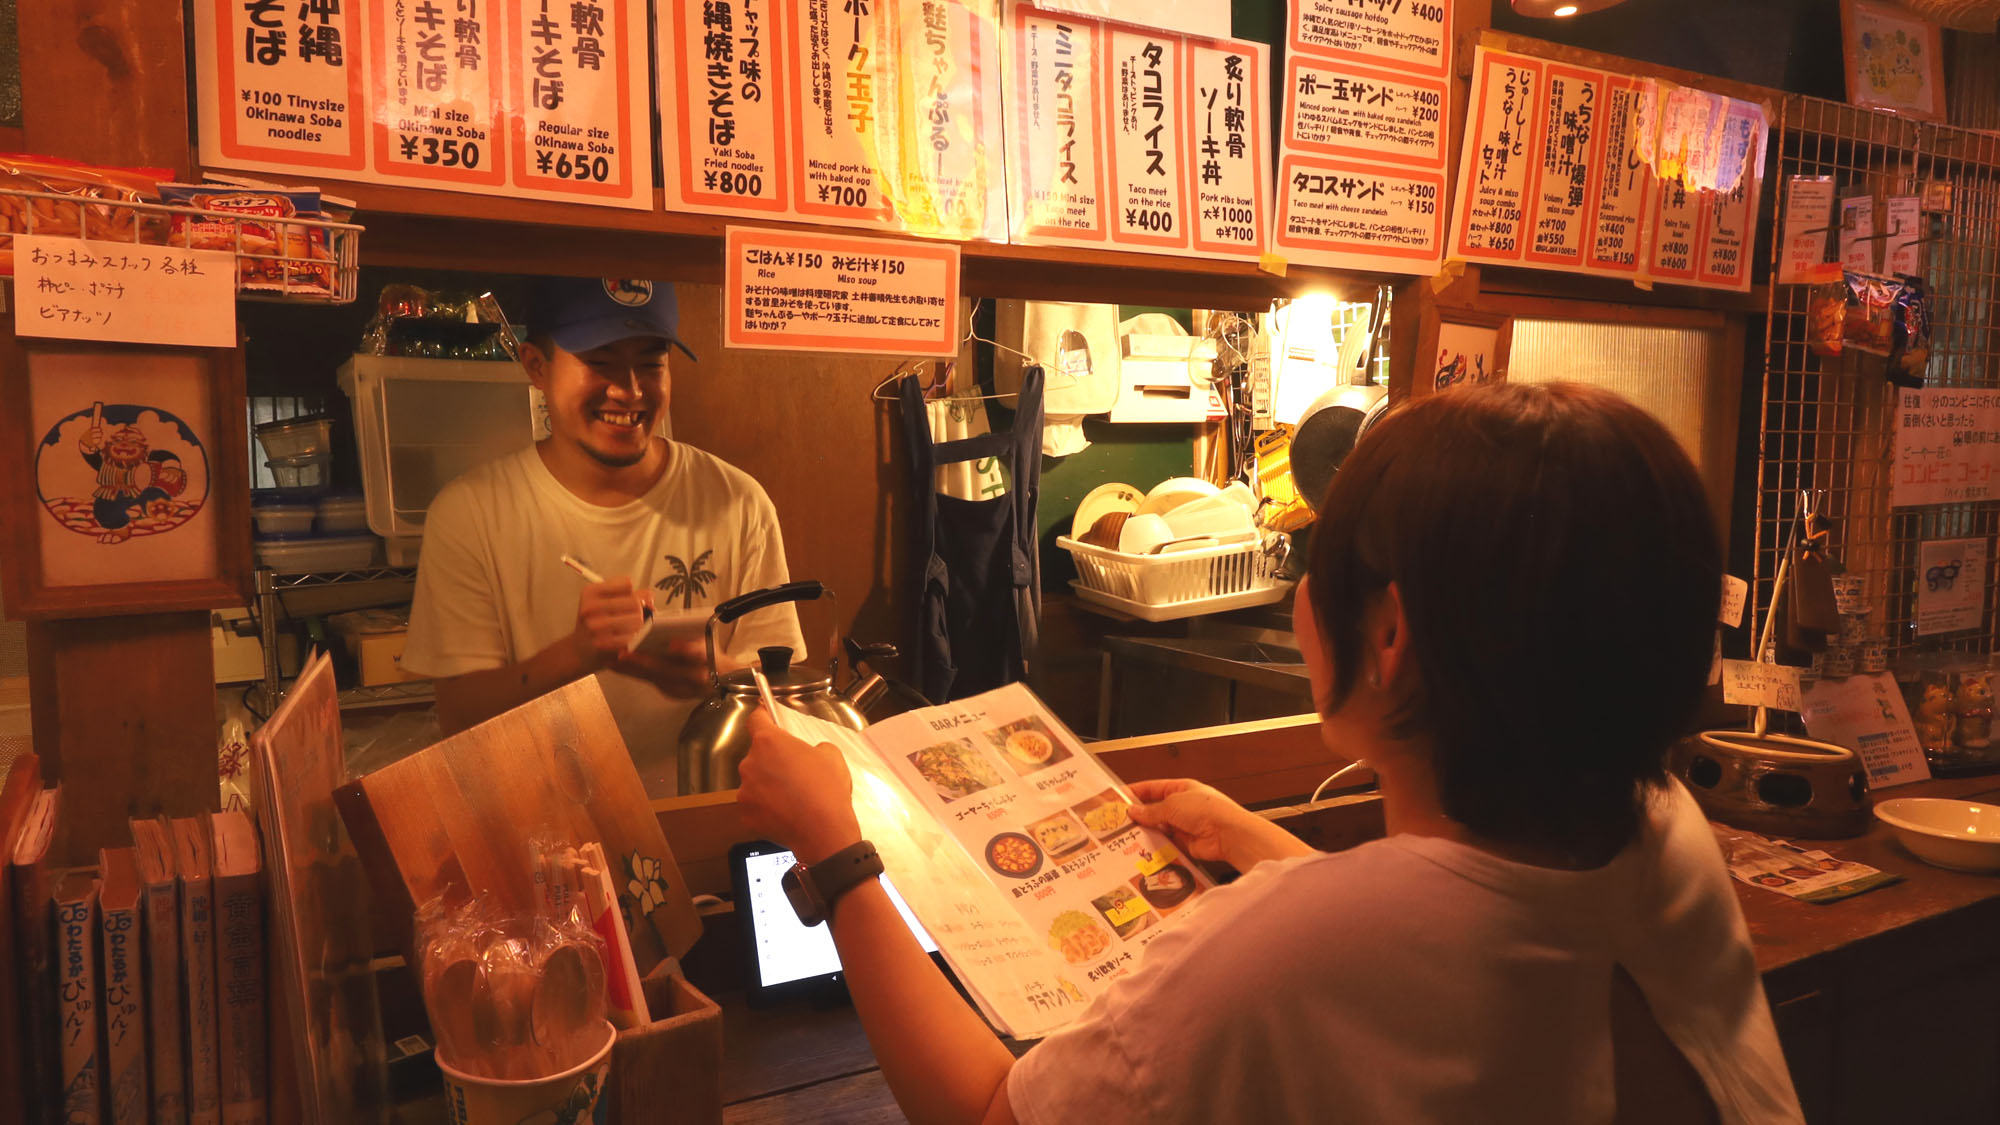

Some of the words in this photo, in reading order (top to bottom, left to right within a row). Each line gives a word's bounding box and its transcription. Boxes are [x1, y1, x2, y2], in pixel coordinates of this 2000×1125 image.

[1314, 2, 1334, 14] Spicy
[1335, 7, 1363, 20] sausage
[1365, 11, 1389, 25] hotdog
[1411, 2, 1443, 24] ¥400
[245, 0, 287, 66] そば
[298, 0, 343, 66] 沖縄
[570, 0, 605, 71] 軟骨
[1299, 73, 1394, 107] ポー玉サンド
[1412, 89, 1439, 107] ¥400
[241, 89, 282, 107] ¥100
[287, 94, 345, 113] Tinysize
[1054, 24, 1078, 184] ミニタコライス
[1141, 41, 1166, 177] タコライス
[1224, 55, 1246, 159] 炙り軟骨
[246, 106, 305, 124] Okinawa
[309, 113, 342, 129] Soba
[413, 105, 441, 120] Mini
[445, 109, 470, 123] size
[1299, 101, 1321, 112] Minced
[1321, 105, 1336, 115] pork
[1337, 107, 1350, 116] ham
[1353, 109, 1366, 119] with
[1366, 111, 1384, 121] baked
[1385, 115, 1396, 124] egg
[1396, 116, 1422, 127] sandwich
[1412, 105, 1438, 122] ¥200
[1512, 70, 1531, 156] じゅーしーと
[268, 127, 322, 142] noodles
[398, 119, 452, 135] Okinawa
[456, 126, 486, 140] Soba
[538, 120, 583, 136] Regular
[587, 127, 610, 139] size
[1493, 67, 1517, 181] うちなー味噌汁
[534, 135, 583, 151] Okinawa
[587, 141, 615, 155] Soba
[1200, 87, 1222, 186] ソーキ丼
[1558, 110, 1578, 177] 味噌汁
[1568, 82, 1594, 208] うちなー爆弾
[400, 134, 480, 169] ¥350
[713, 148, 732, 158] Yaki
[735, 150, 755, 160] Soba
[535, 150, 609, 182] ¥650
[704, 158, 728, 169] Fried
[731, 162, 764, 173] noodles
[809, 160, 837, 171] Minced
[839, 163, 859, 174] pork
[1480, 144, 1495, 185] セット
[703, 170, 762, 197] ¥800
[809, 172, 828, 181] with
[829, 174, 853, 184] baked
[855, 178, 870, 187] egg
[1128, 183, 1147, 195] Taco
[1293, 172, 1385, 201] タコスサンド
[818, 184, 867, 208] ¥700
[1079, 194, 1095, 205] size
[1201, 192, 1219, 204] Pork
[1220, 193, 1235, 205] ribs
[1236, 196, 1253, 207] bowl
[1408, 183, 1435, 199] ¥300
[1479, 185, 1496, 196] Juicy
[1498, 187, 1504, 196] &
[1504, 189, 1519, 199] miso
[920, 194, 967, 217] ¥00
[1128, 198, 1139, 206] on
[1141, 196, 1155, 207] the
[1156, 197, 1171, 208] rice
[1293, 200, 1307, 209] Taco
[1326, 203, 1339, 212] with
[1340, 205, 1360, 214] cheese
[1362, 207, 1388, 217] sandwich
[1407, 199, 1434, 215] ¥150
[1479, 198, 1495, 207] soup
[1496, 199, 1516, 209] combo
[1058, 216, 1072, 227] the
[1074, 218, 1090, 228] rice
[1125, 208, 1173, 233] ¥400
[1488, 236, 1515, 251] ¥650
[31, 247, 152, 271] おつまみスナック
[160, 256, 205, 276] 各種
[1613, 251, 1635, 265] ¥150
[758, 269, 776, 279] Rice
[837, 274, 856, 285] Miso
[858, 277, 877, 286] soup
[930, 711, 987, 731] BARメニュー
